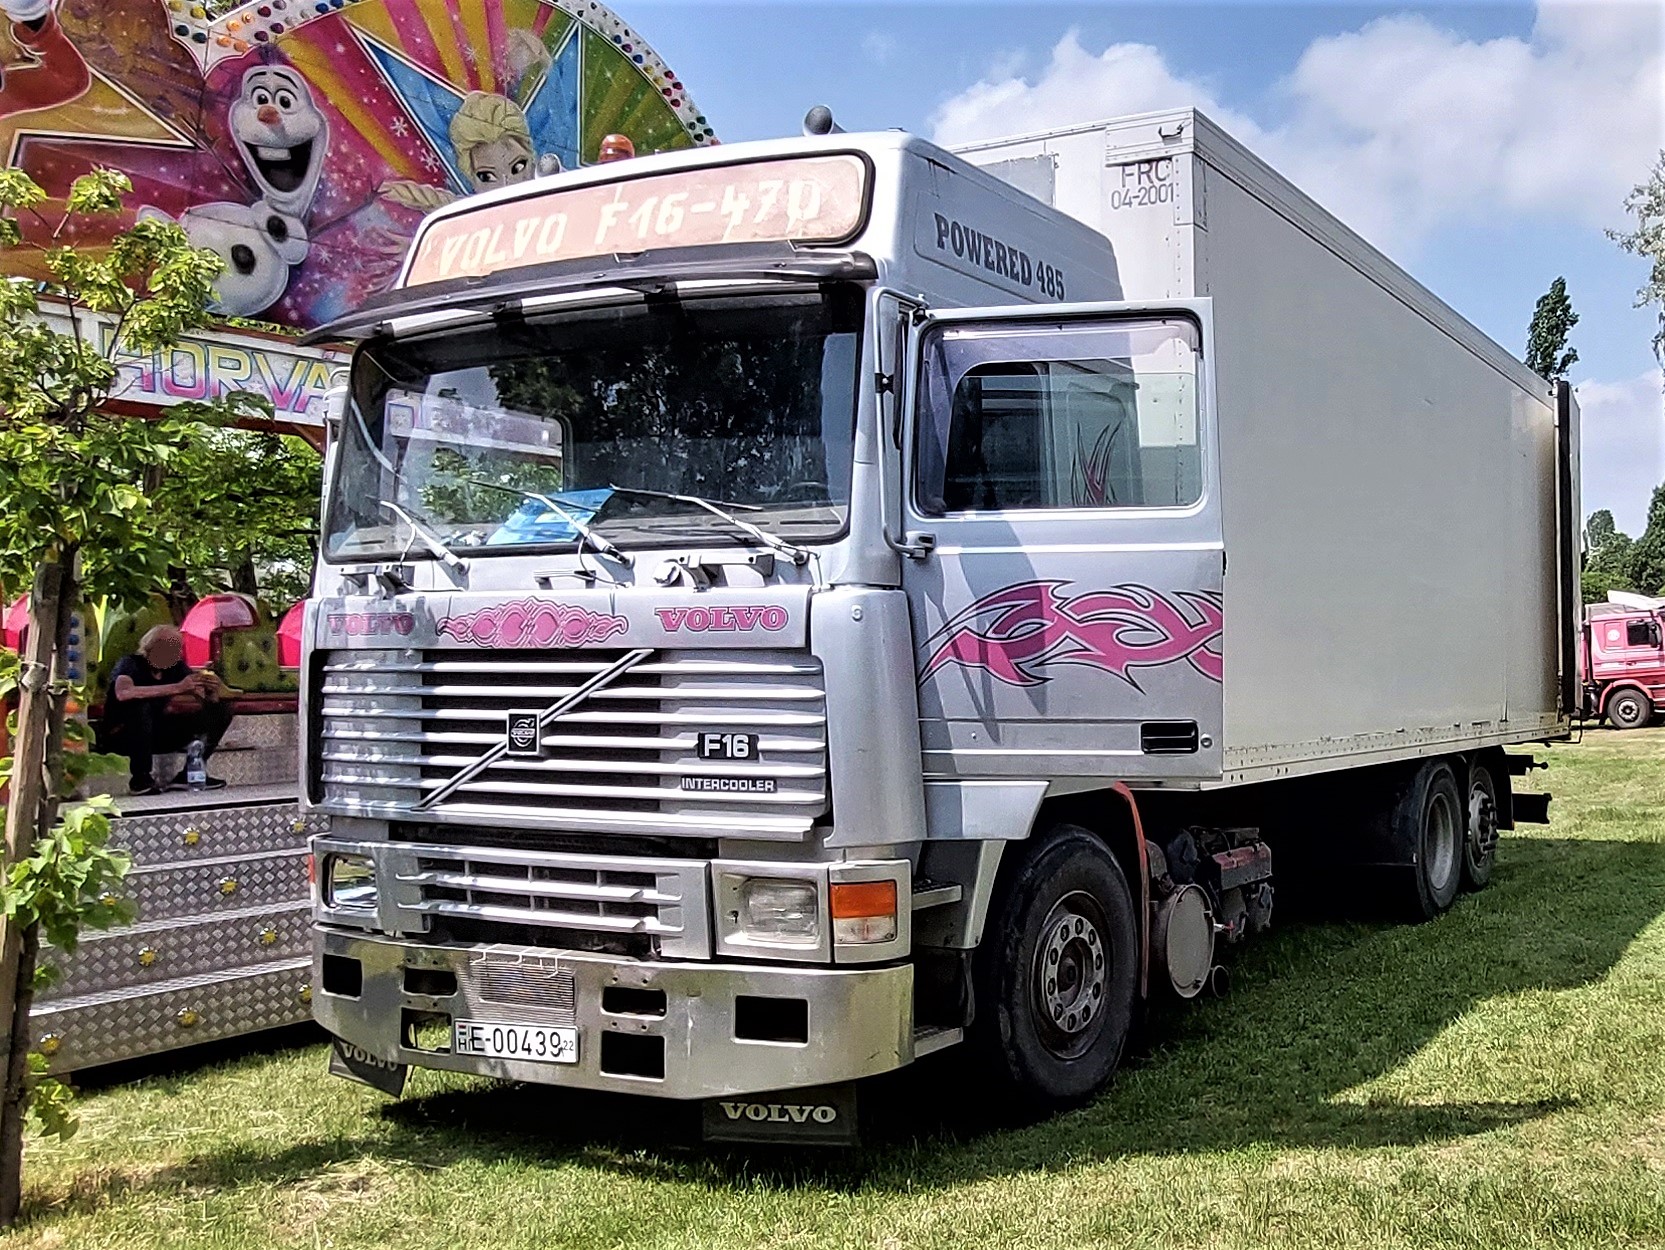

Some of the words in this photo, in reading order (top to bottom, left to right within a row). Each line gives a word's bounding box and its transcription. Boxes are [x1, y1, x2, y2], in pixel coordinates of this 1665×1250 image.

[1121, 160, 1170, 188] FRC
[1111, 182, 1174, 210] 04-2001
[438, 213, 568, 276] VOLVO
[934, 212, 1032, 286] POWERED
[1036, 260, 1065, 301] 485
[327, 613, 416, 636] VOLVO
[654, 605, 789, 632] VOLVO
[704, 734, 749, 758] F16
[681, 777, 775, 792] INTERCOOLER
[470, 1026, 562, 1058] E-00439
[719, 1102, 837, 1123] VOLVO
